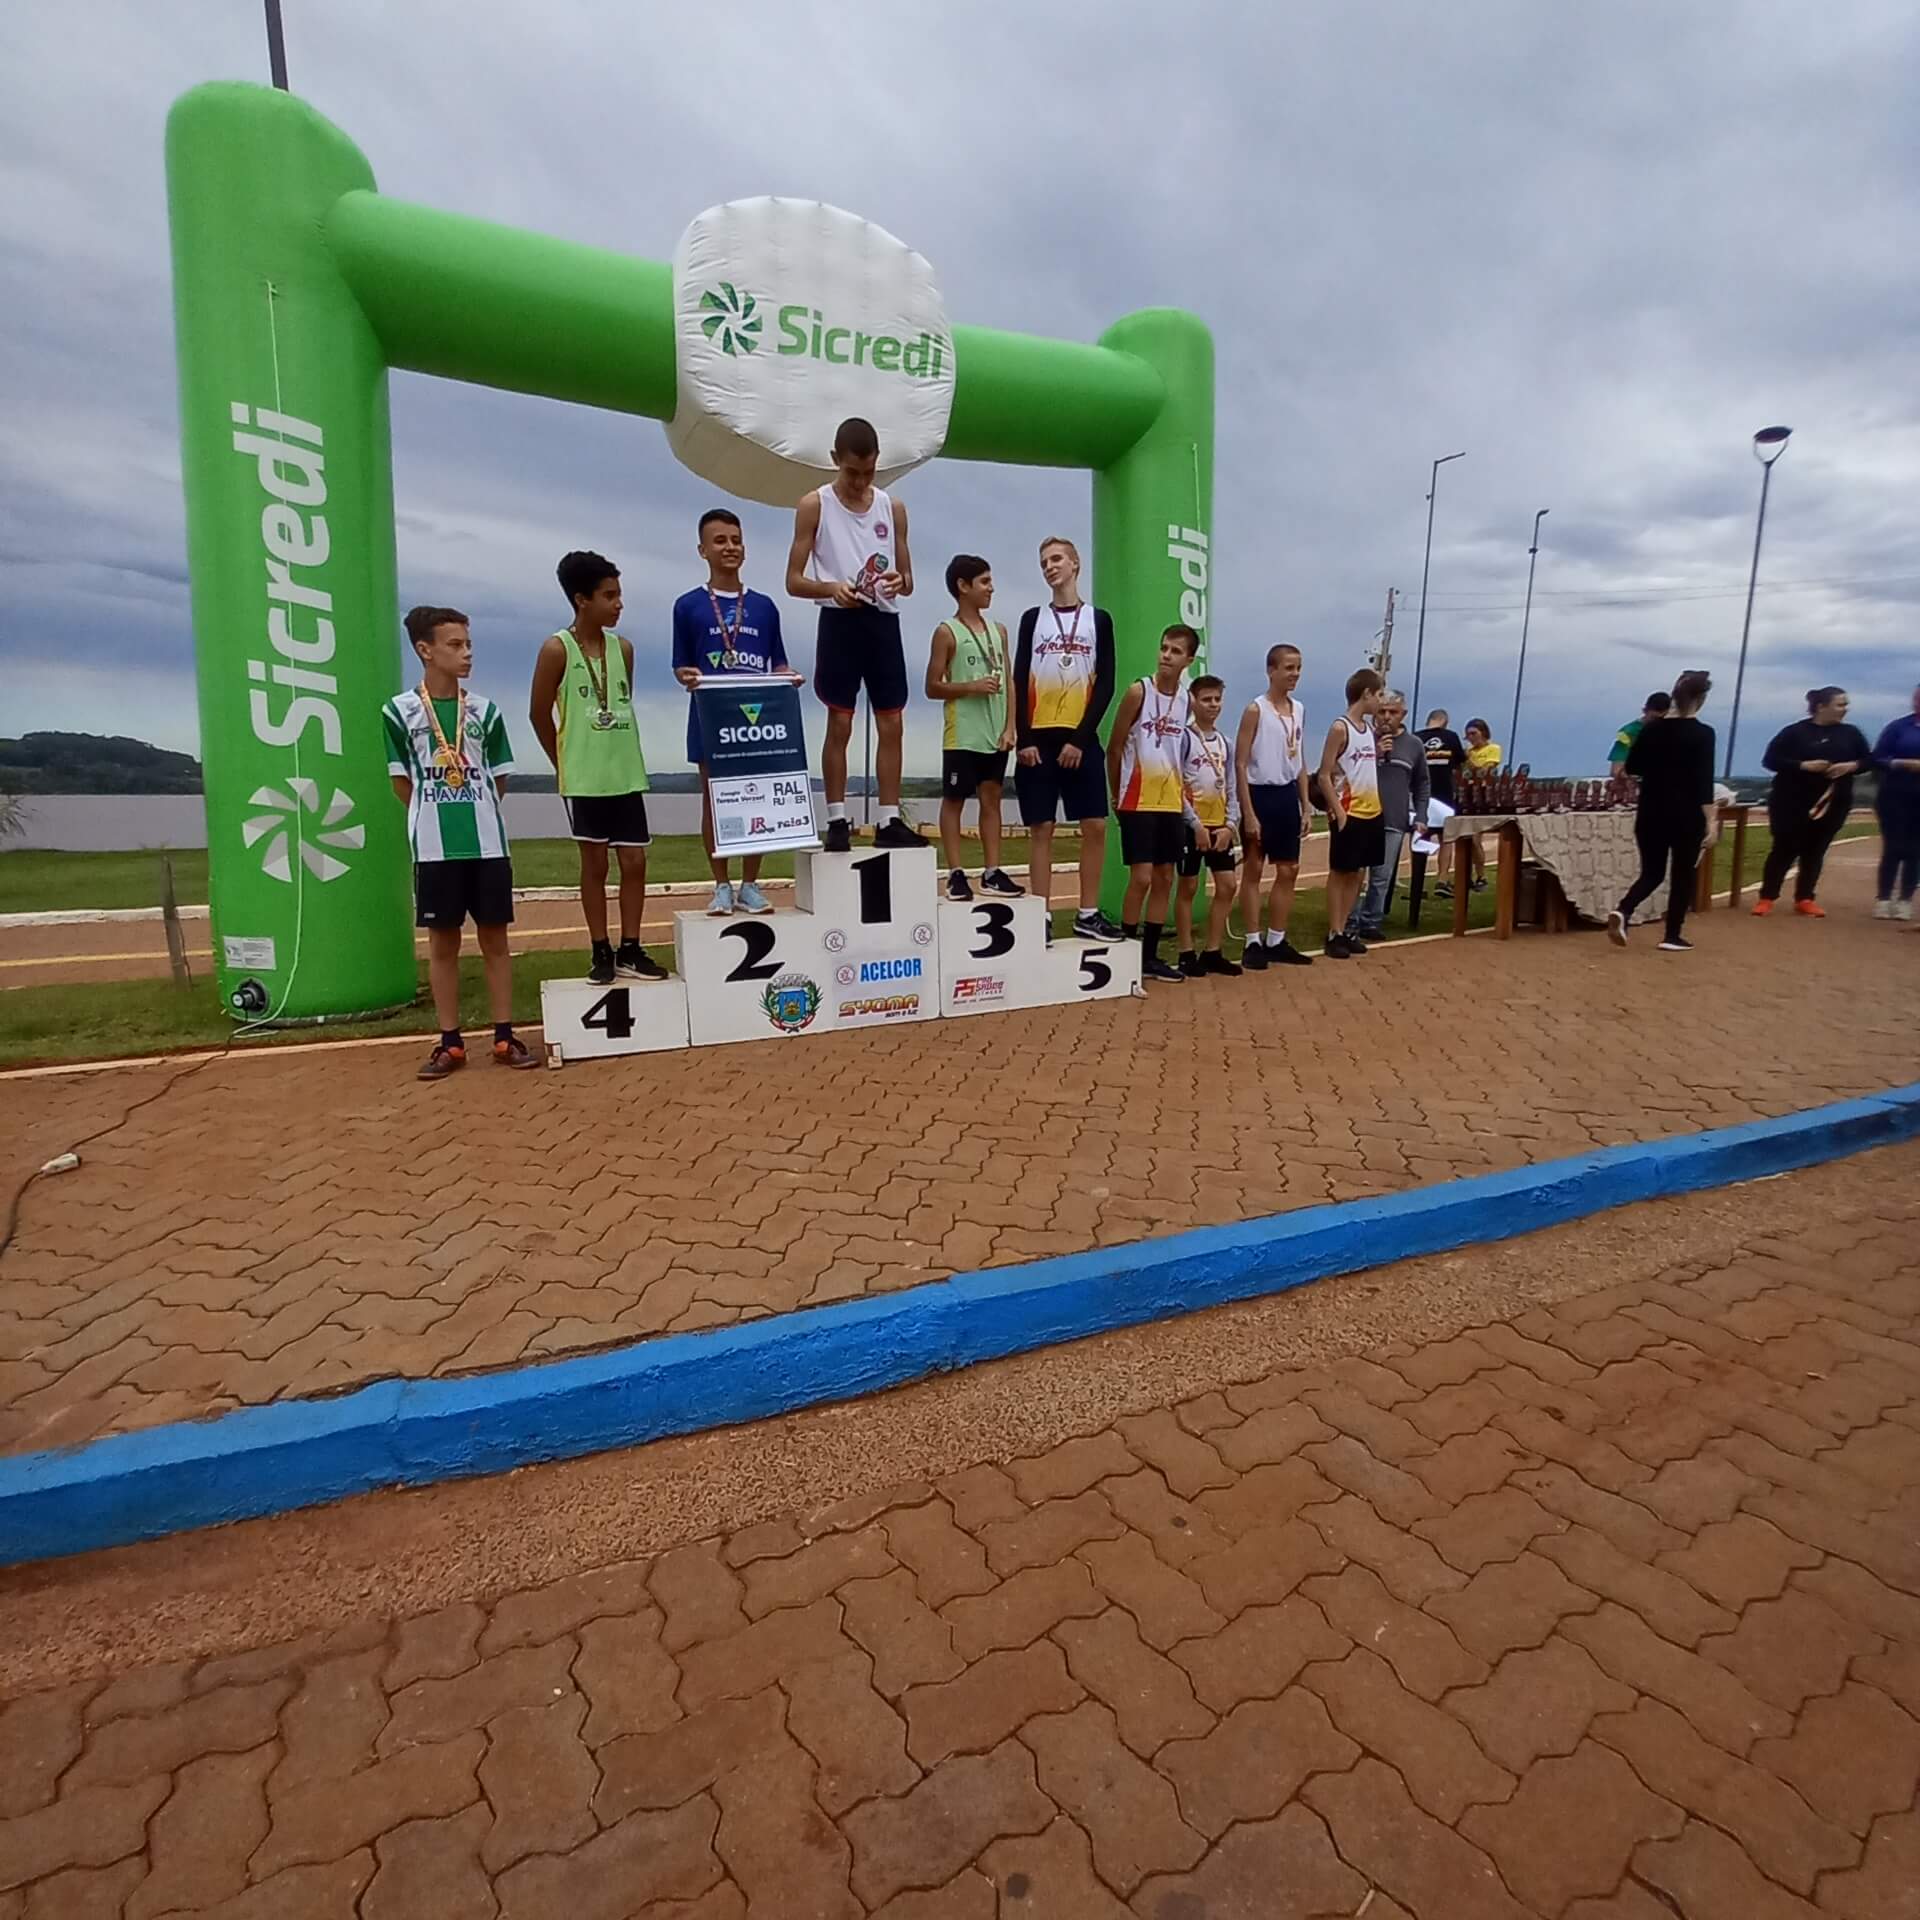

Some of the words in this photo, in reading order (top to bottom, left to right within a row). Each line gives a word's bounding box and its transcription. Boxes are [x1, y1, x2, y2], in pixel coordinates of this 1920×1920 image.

[777, 305, 942, 380] Sicredi
[230, 401, 342, 756] Sicredi
[719, 724, 787, 744] SICOOB
[424, 788, 483, 802] HAVAN
[851, 851, 892, 924] 1
[719, 920, 786, 983] 2
[968, 902, 1015, 959] 3
[860, 958, 922, 982] ACELCOR
[1078, 947, 1112, 991] 5
[580, 987, 636, 1039] 4
